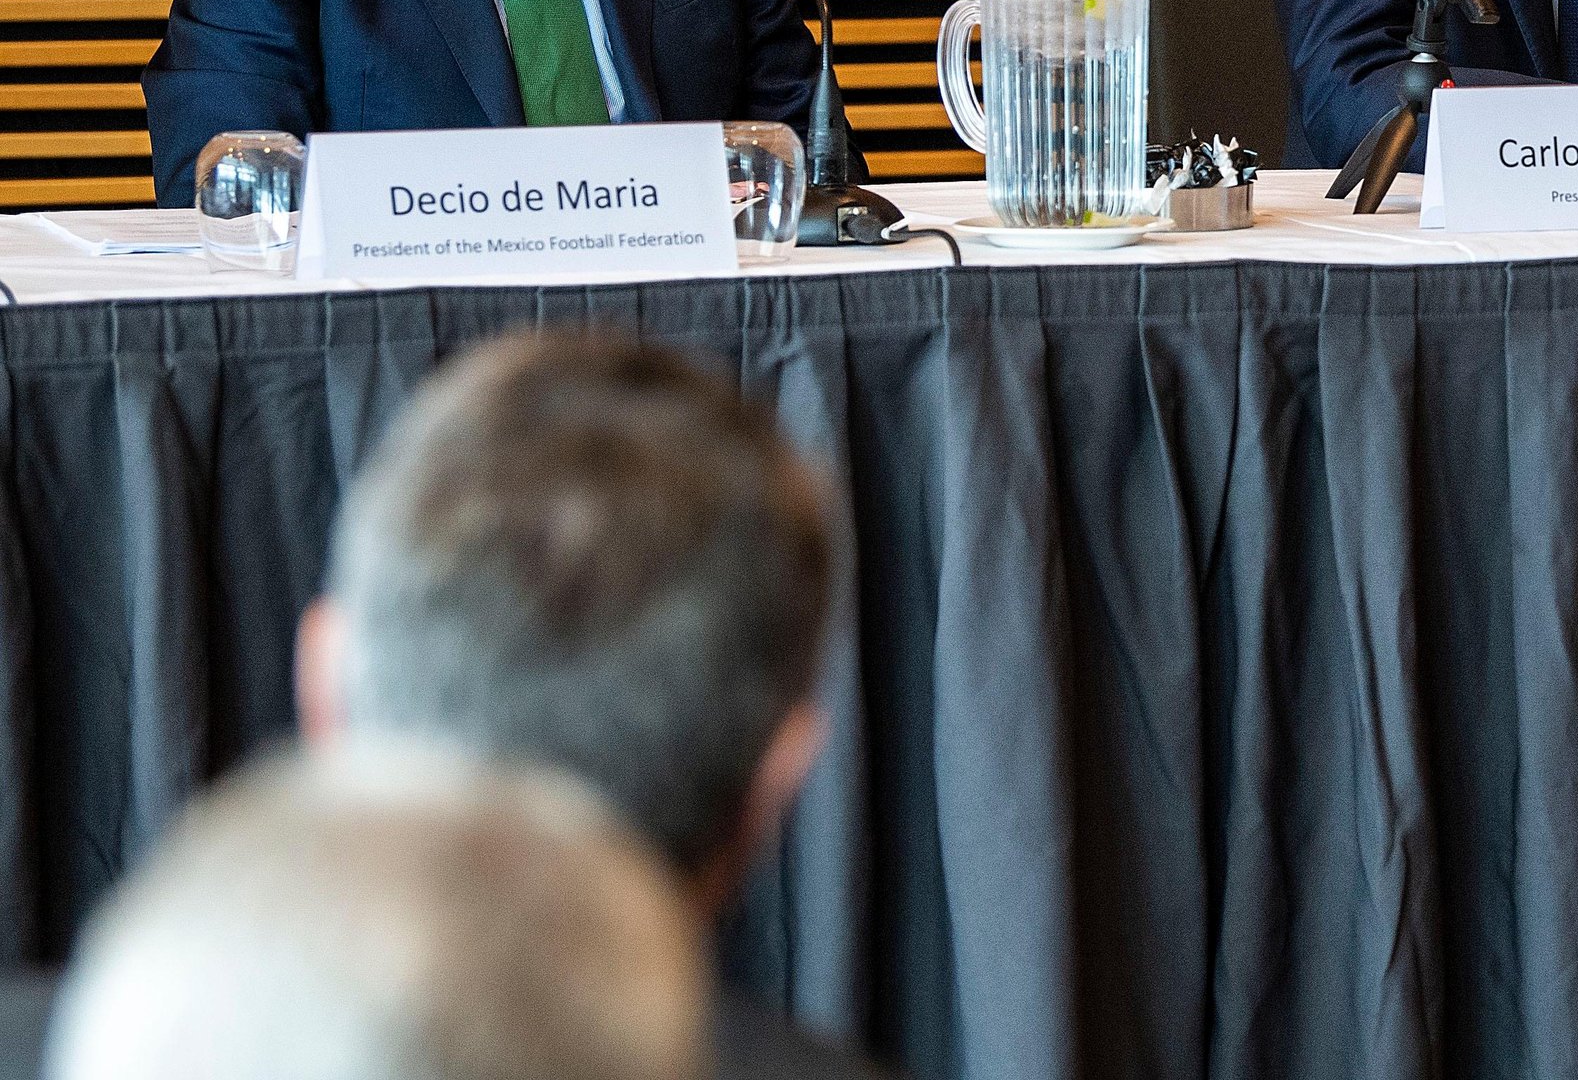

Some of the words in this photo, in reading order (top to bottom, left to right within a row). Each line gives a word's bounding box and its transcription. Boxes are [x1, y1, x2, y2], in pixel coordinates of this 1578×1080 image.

[390, 183, 489, 216] Decio
[502, 180, 544, 212] de
[556, 177, 660, 211] Maria
[353, 241, 430, 258] President
[434, 239, 452, 256] of
[455, 239, 483, 255] the
[487, 238, 546, 253] Mexico
[549, 233, 614, 251] Football
[618, 232, 705, 248] Federation
